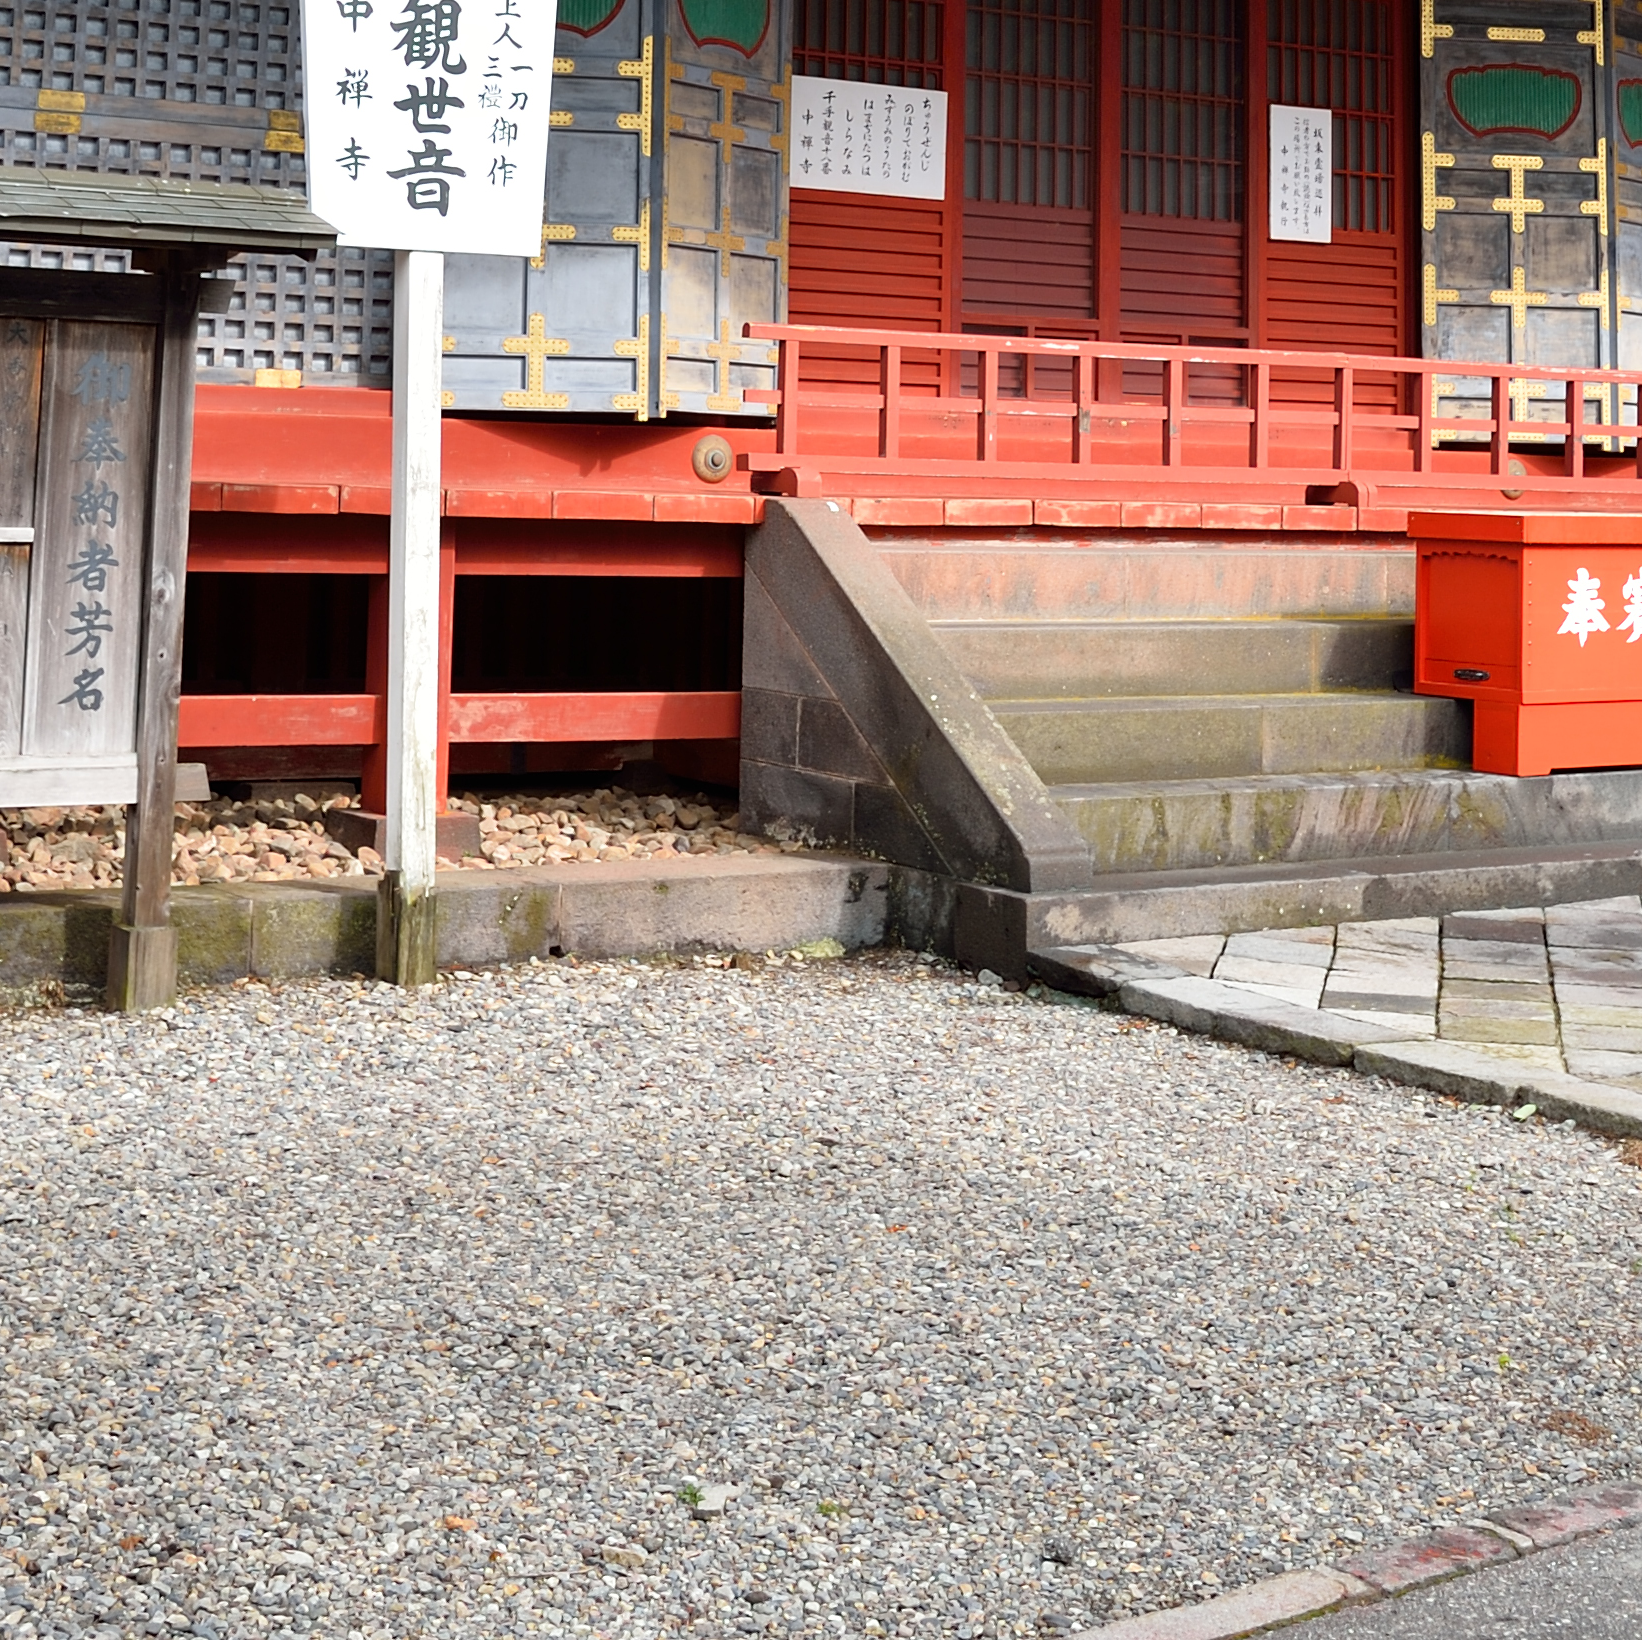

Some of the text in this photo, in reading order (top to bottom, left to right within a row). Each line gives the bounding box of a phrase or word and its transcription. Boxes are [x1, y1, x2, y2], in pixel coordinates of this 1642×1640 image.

[841, 109, 854, 175] しらなみ
[920, 97, 933, 172] ちゅうぜんじ
[58, 351, 132, 713] 御奉納者芳名
